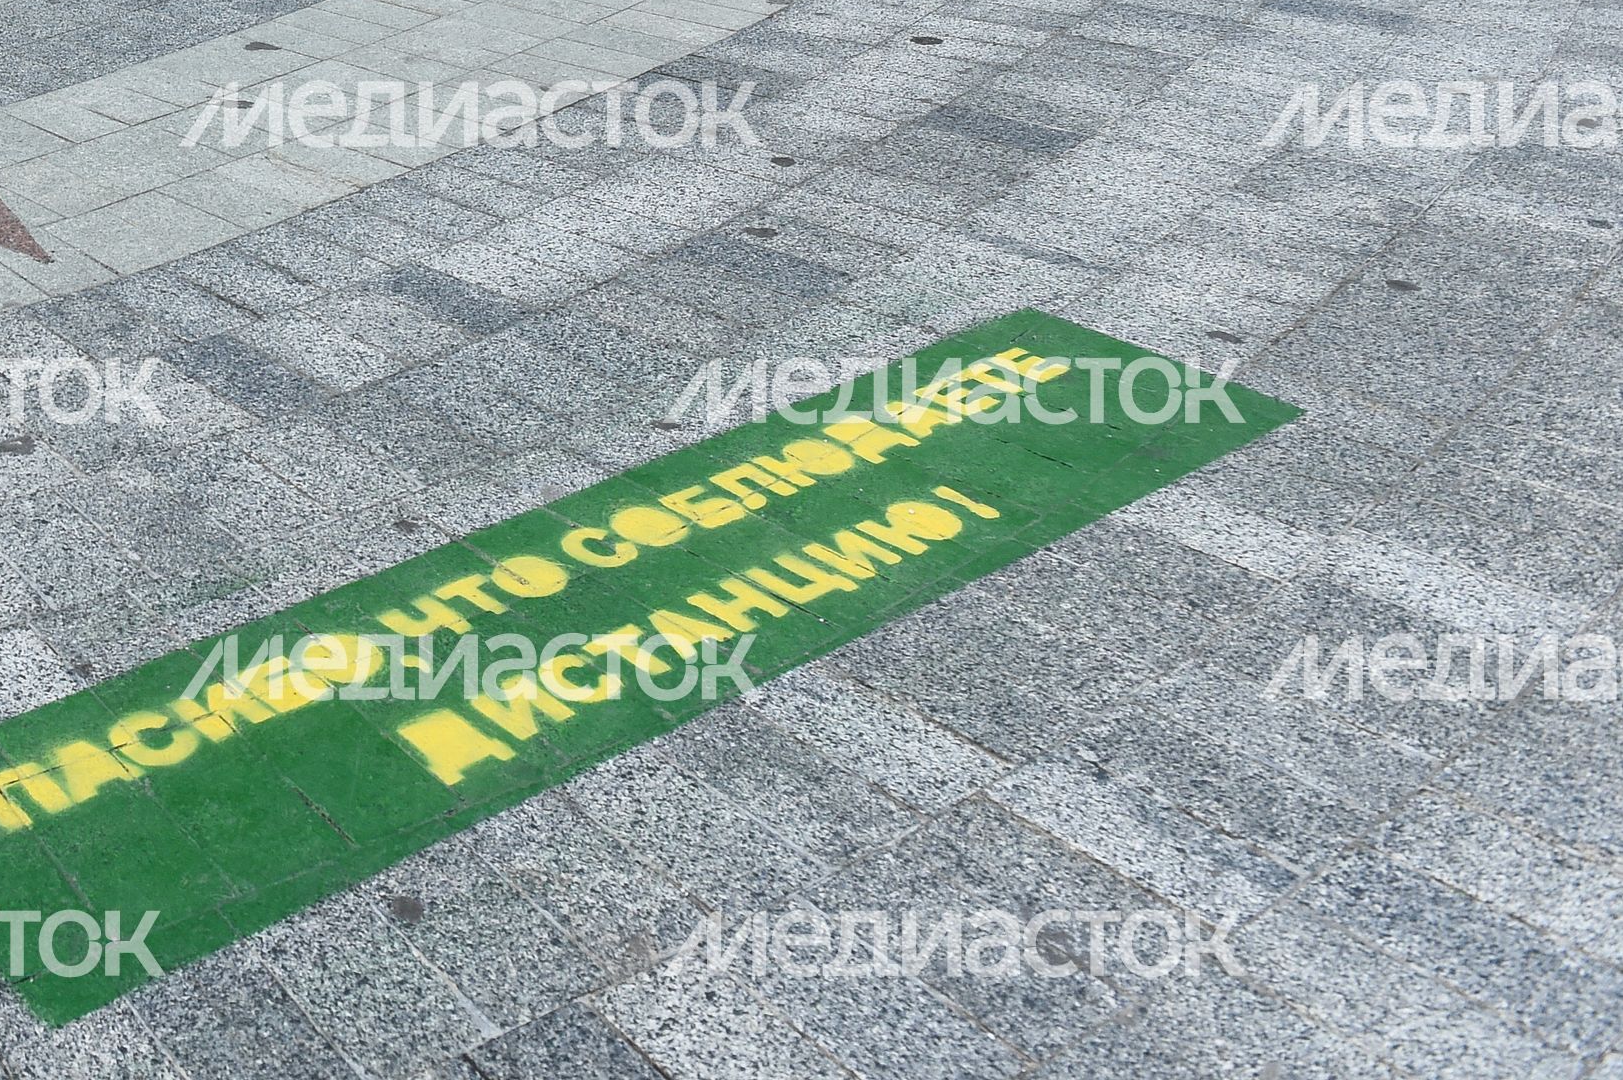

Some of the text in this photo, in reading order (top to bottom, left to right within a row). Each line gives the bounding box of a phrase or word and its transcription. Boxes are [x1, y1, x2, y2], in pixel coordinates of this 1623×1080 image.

[378, 555, 570, 639] ЧТО
[560, 346, 1071, 569] СОБЛЮДАЕТЕ
[395, 485, 1001, 787] ДИСТАНЦИЮ!
